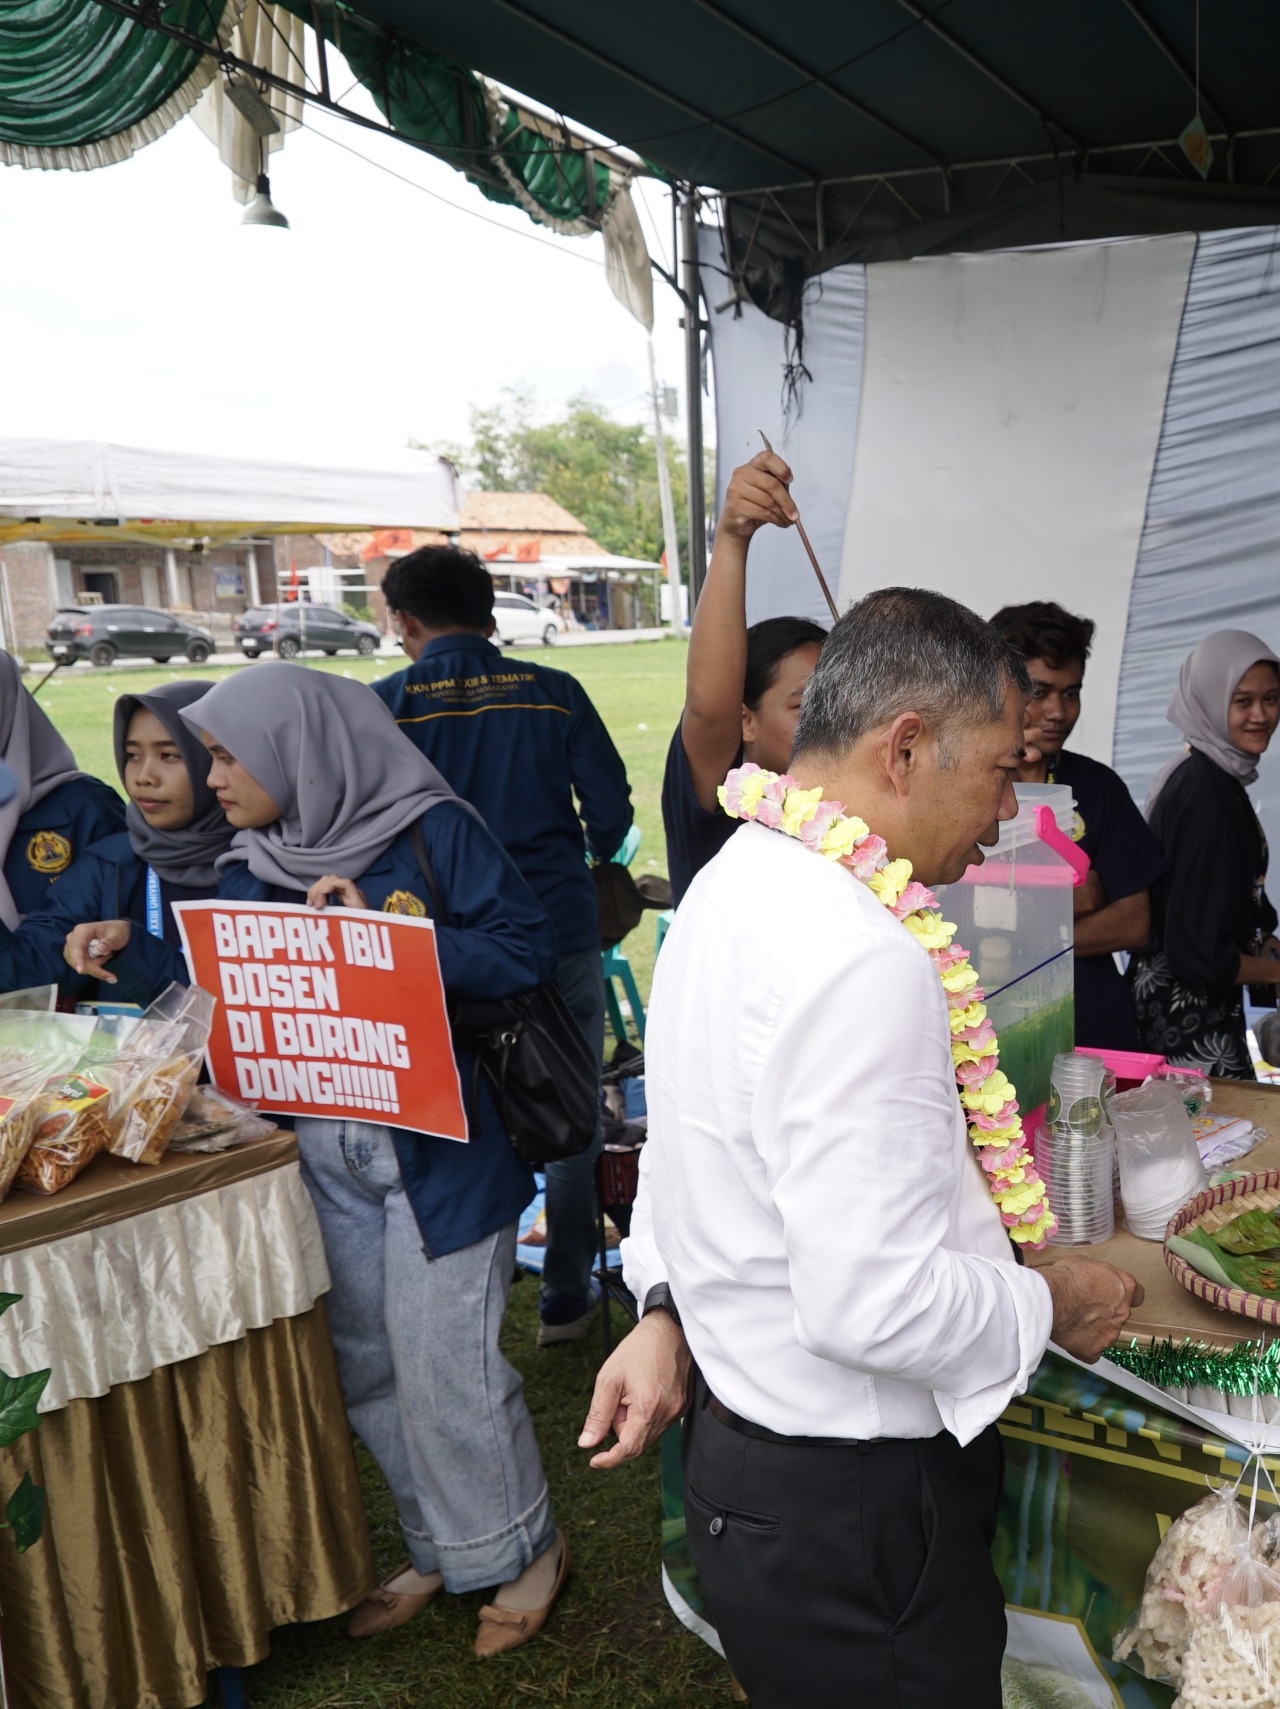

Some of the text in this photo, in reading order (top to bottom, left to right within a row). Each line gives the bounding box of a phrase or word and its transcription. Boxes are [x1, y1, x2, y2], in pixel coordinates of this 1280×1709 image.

[430, 678, 456, 691] PPM
[490, 673, 536, 684] TEMATIK
[212, 912, 395, 971] BAPAK IBU
[218, 961, 340, 1012] DOSEN
[225, 1009, 411, 1070] DI BORONG
[234, 1056, 400, 1115] DONG!!!!!!!
